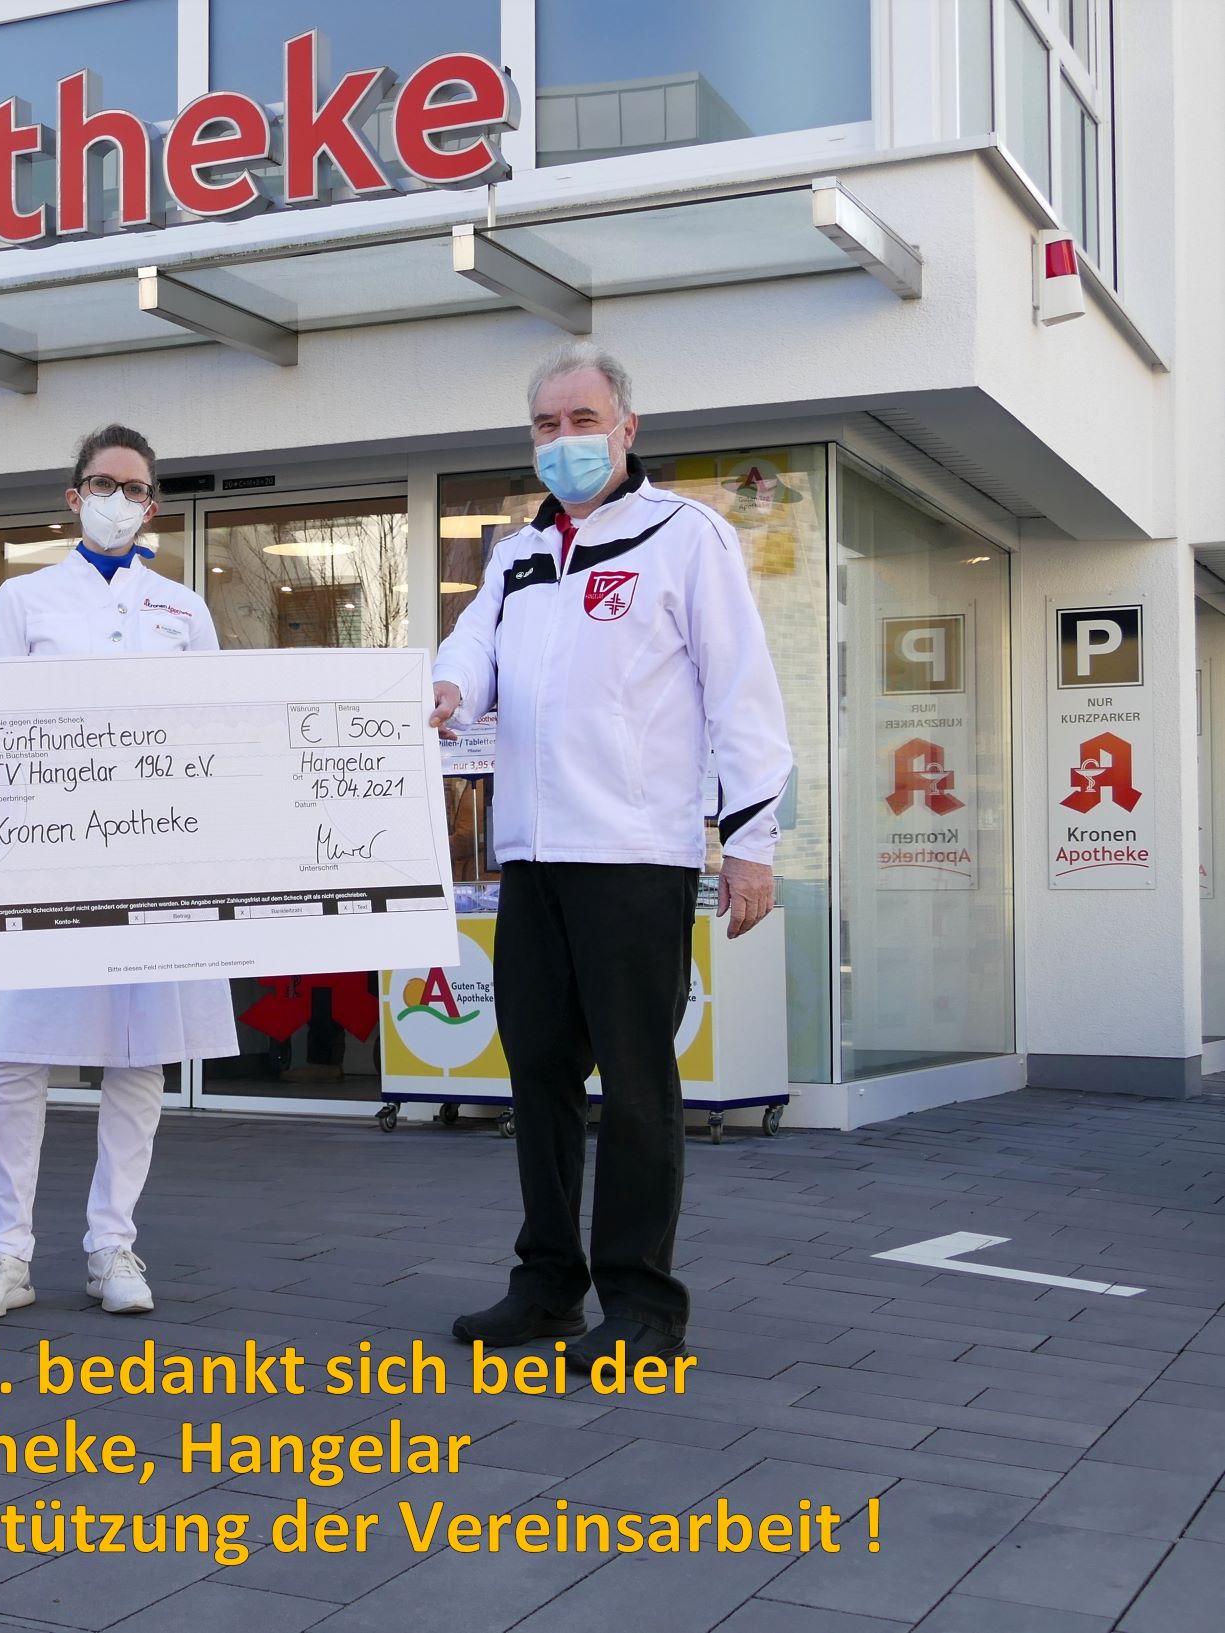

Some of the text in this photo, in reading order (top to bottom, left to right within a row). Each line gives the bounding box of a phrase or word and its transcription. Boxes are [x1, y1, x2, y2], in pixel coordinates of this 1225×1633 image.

[593, 575, 626, 593] TV
[1076, 618, 1123, 677] P
[338, 704, 360, 712] Betrag
[1087, 697, 1113, 707] NUR
[290, 705, 320, 714] Währung
[9, 719, 31, 728] gegen
[33, 717, 57, 725] diesen
[58, 716, 85, 724] Scheck
[1061, 712, 1141, 724] KURZPARKER
[300, 712, 323, 744] €
[347, 717, 411, 740] 500,-
[5, 751, 49, 760] Buchstaben
[300, 751, 386, 781] Hangelar
[453, 762, 468, 770] nur
[470, 760, 488, 771] 3,95
[29, 757, 118, 792] Hangelar
[134, 755, 174, 779] 1962
[184, 754, 215, 778] e.V.
[311, 776, 405, 799] 15.04.2021
[85, 806, 199, 848] Apotheke
[1067, 827, 1137, 842] Kronen
[1055, 846, 1149, 865] Apotheke
[299, 864, 339, 872] Unterschrift
[90, 904, 115, 912] geändert
[190, 899, 212, 907] Angabe
[208, 960, 220, 968] und
[451, 982, 475, 990] Guten
[456, 994, 494, 1004] Apotheke
